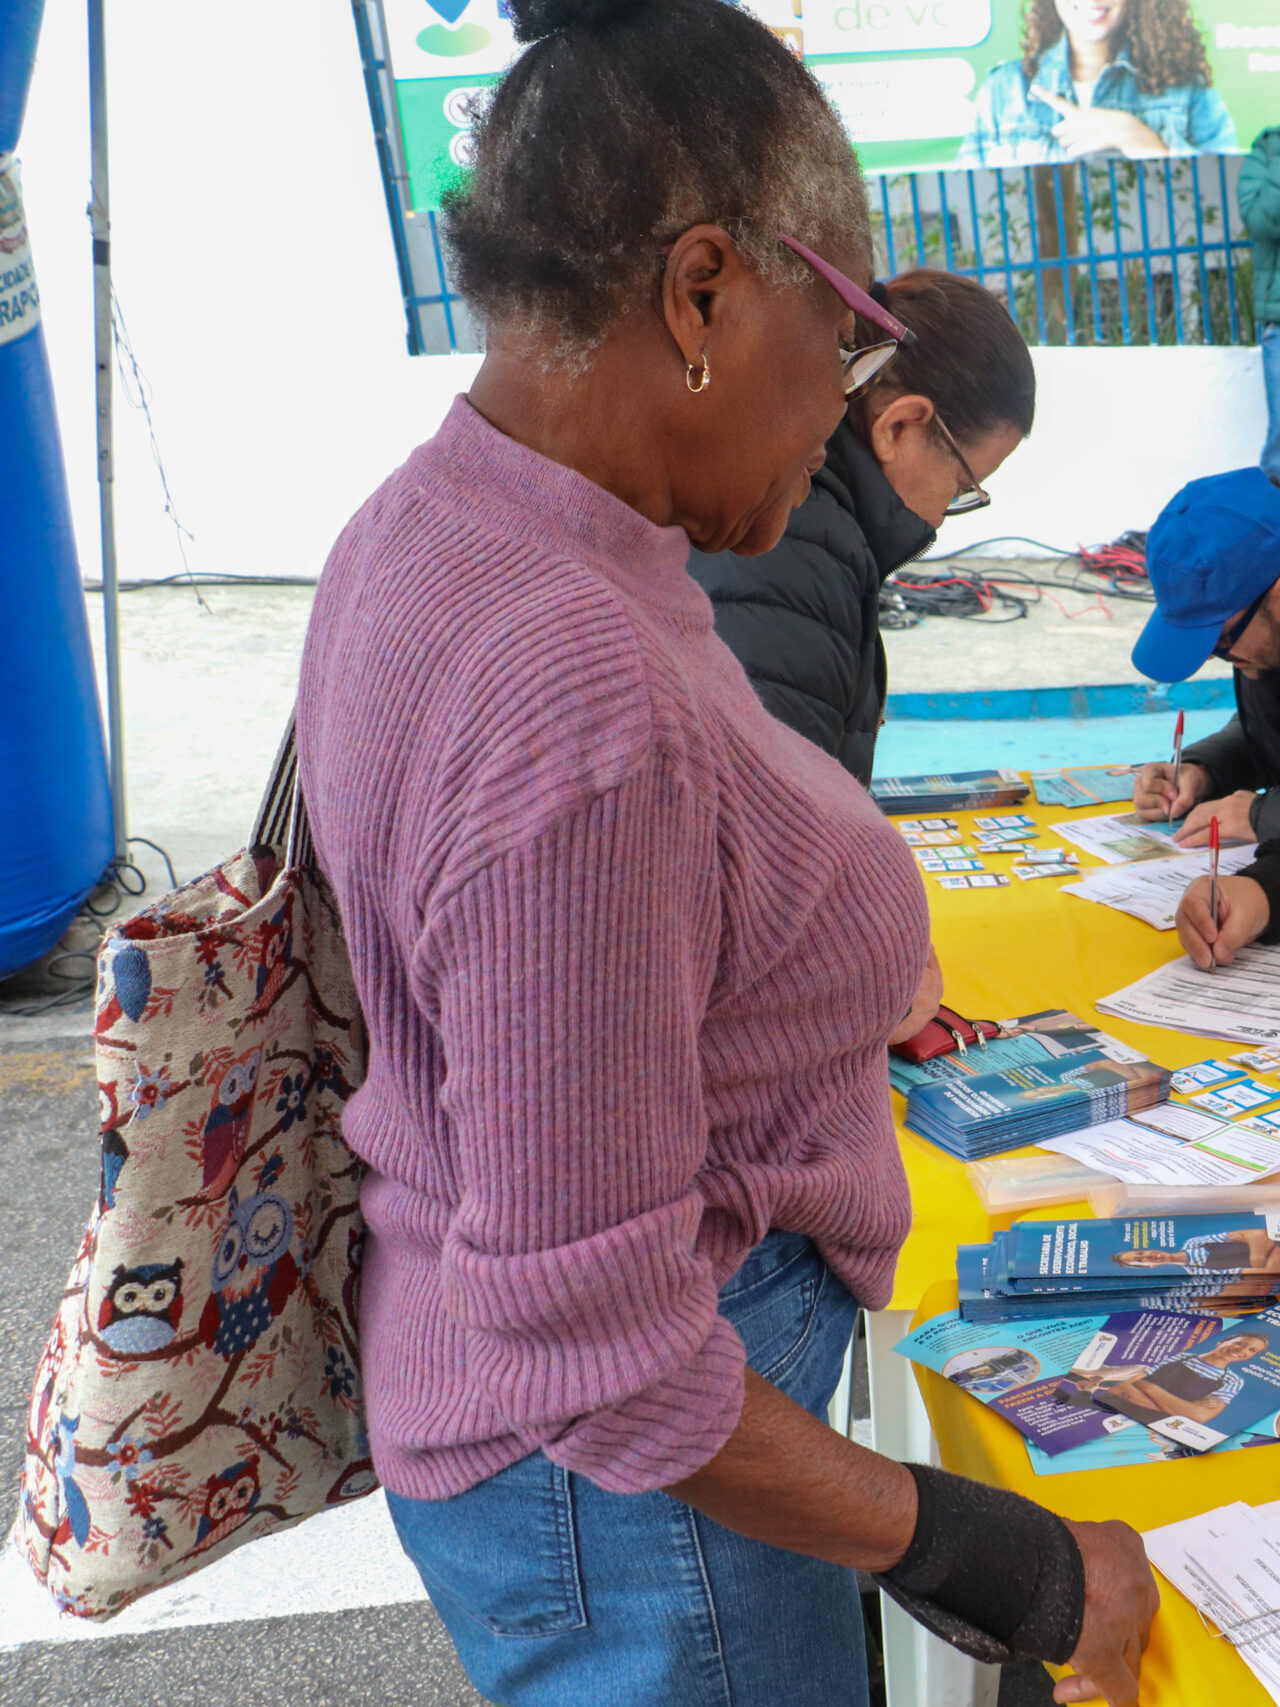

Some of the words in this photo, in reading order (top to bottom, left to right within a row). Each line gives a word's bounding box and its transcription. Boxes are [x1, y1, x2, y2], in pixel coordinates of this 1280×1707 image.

[1043, 1234, 1052, 1242] DE
[1068, 1222, 1078, 1240] SOCIAL
[1123, 1232, 1131, 1242] Para
[1039, 1242, 1050, 1275] SECRETARIA
[1052, 1225, 1065, 1274] DESENVOLVIMENTO
[1065, 1240, 1078, 1274] ECONÔMICO,
[1079, 1240, 1089, 1268] TRABALHO
[913, 1325, 936, 1343] PARA
[1022, 1327, 1069, 1343] ENCONTRA
[1024, 1328, 1042, 1338] QUE
[1241, 1366, 1263, 1378] apoio
[998, 1386, 1048, 1405] PARCERIAS
[1004, 1396, 1035, 1409] FAZEM
